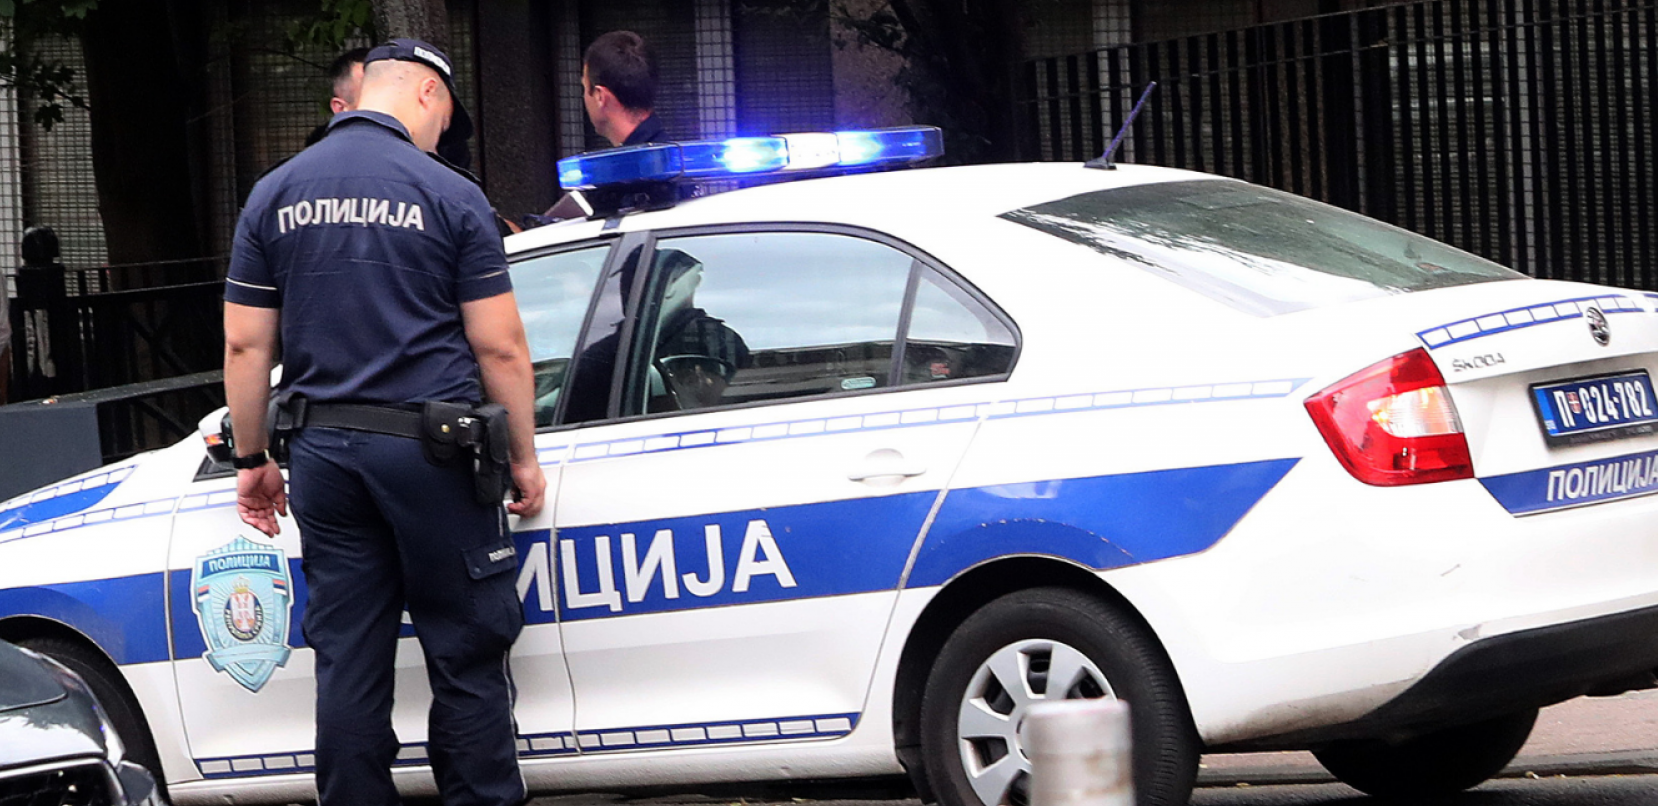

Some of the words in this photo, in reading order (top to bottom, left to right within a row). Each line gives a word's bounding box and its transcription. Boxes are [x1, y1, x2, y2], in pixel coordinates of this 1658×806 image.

[278, 197, 425, 234] ПОЛИЦИЈА
[1547, 455, 1658, 500] ПОЛИЦИЈА
[208, 555, 271, 572] ПОЛИЦИЈА
[515, 519, 797, 612] ИЦИЈА
